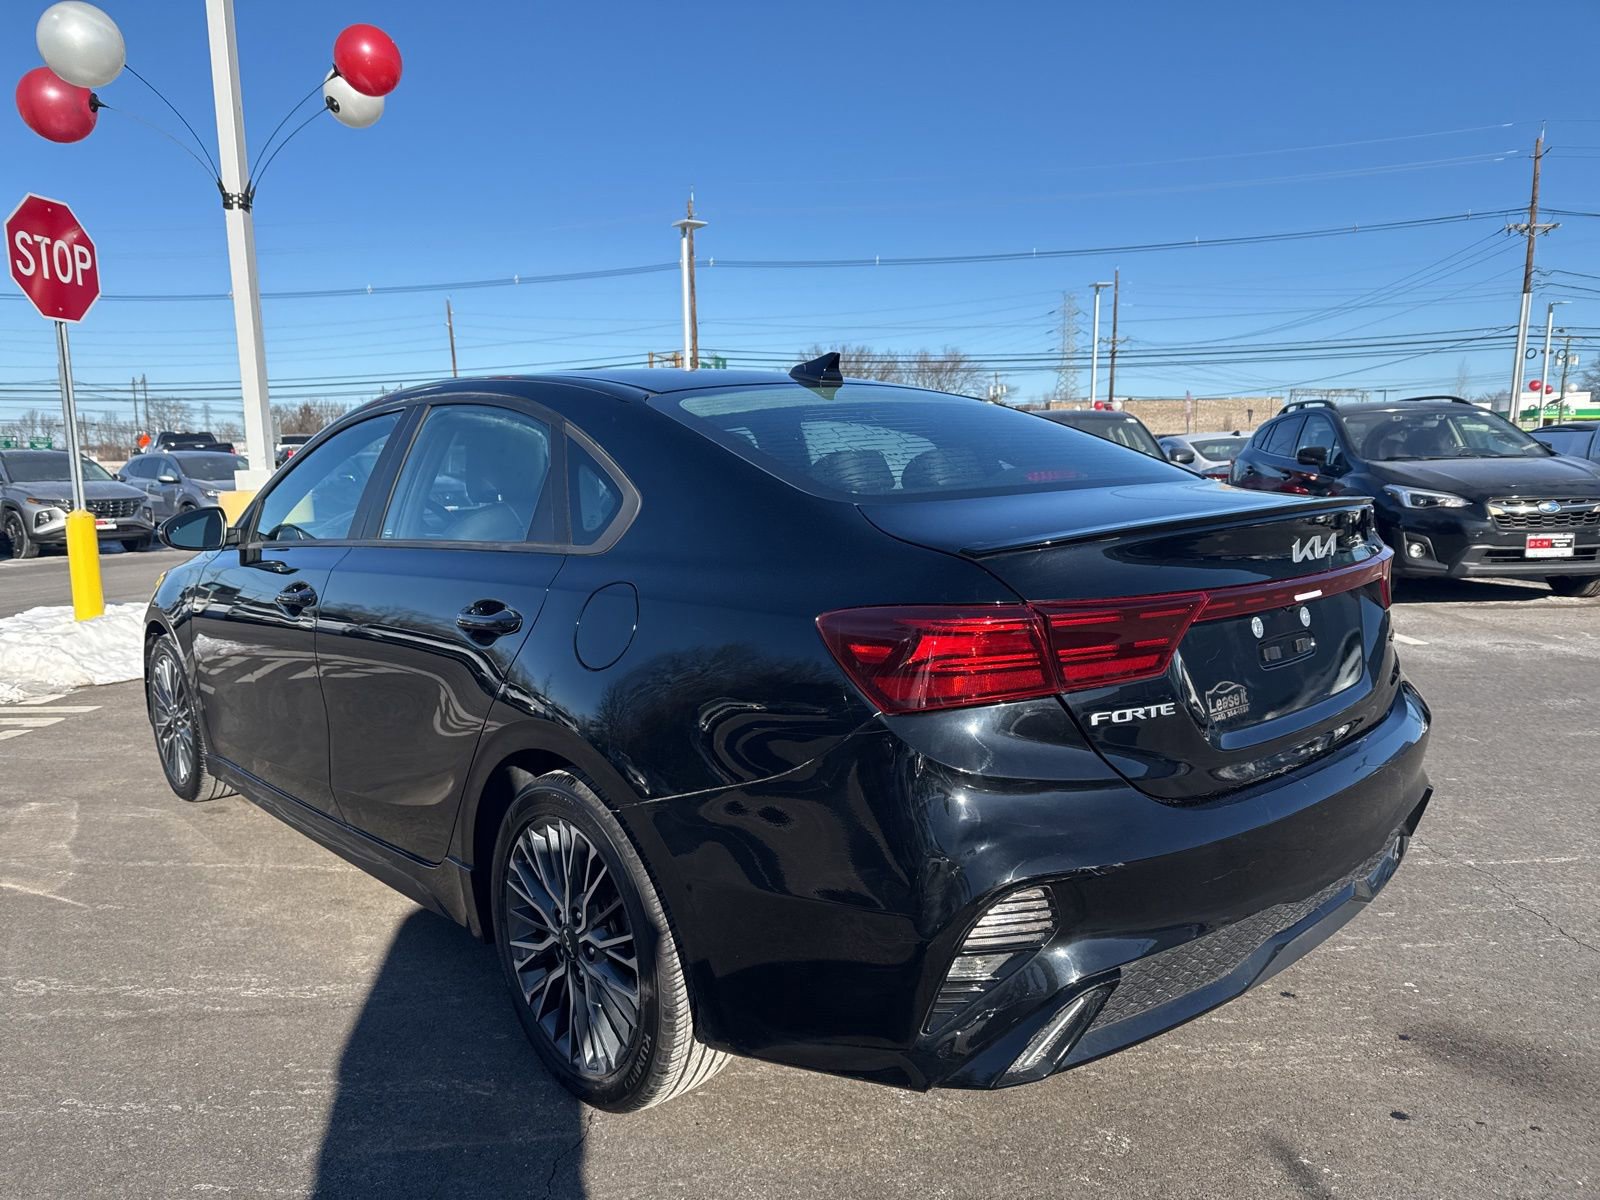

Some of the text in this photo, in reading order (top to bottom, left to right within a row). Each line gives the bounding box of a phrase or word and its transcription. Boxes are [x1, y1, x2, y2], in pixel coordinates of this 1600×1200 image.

[15, 230, 92, 286] STOP
[1292, 532, 1336, 563] KIA
[1091, 702, 1176, 726] FORTE
[1208, 694, 1240, 713] Lease
